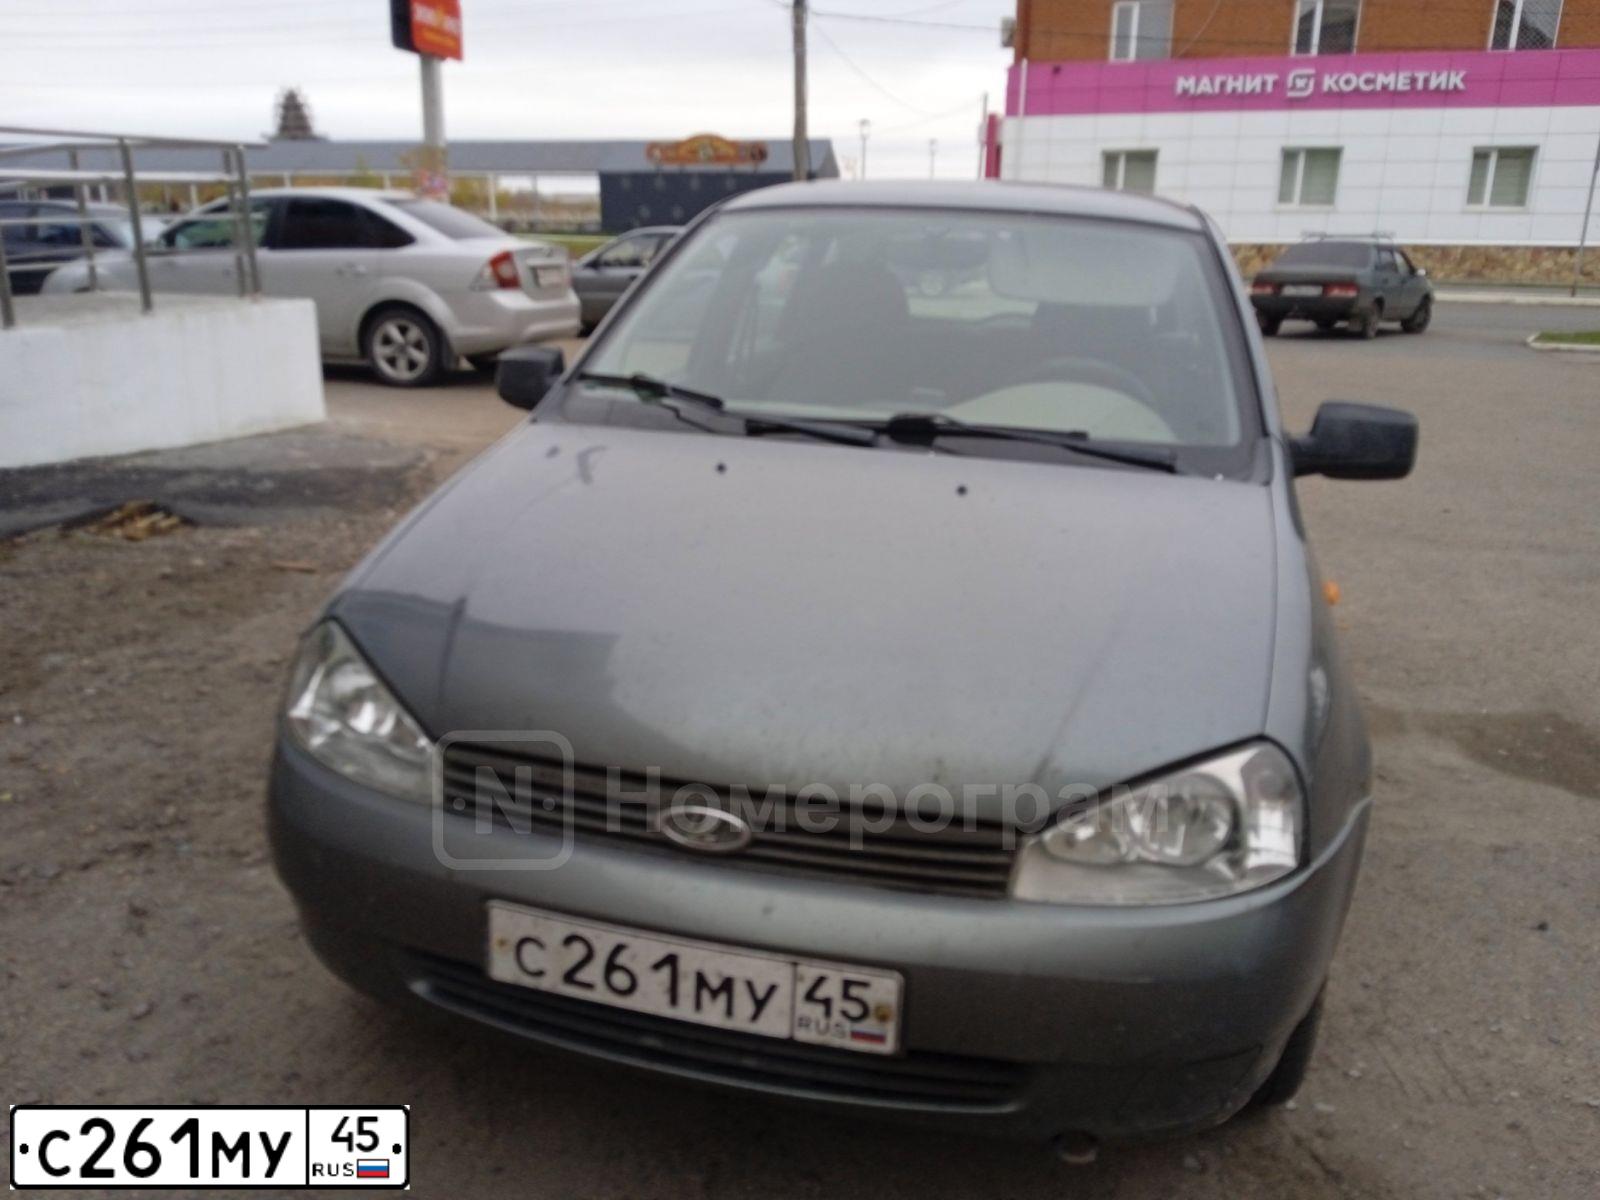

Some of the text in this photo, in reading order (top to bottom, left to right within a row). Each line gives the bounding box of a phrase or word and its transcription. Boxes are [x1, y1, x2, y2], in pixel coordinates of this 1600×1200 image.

[1175, 70, 1467, 97] МАГНИТ КОСМЕТИК
[804, 976, 871, 1022] 45
[798, 1017, 846, 1039] RUS
